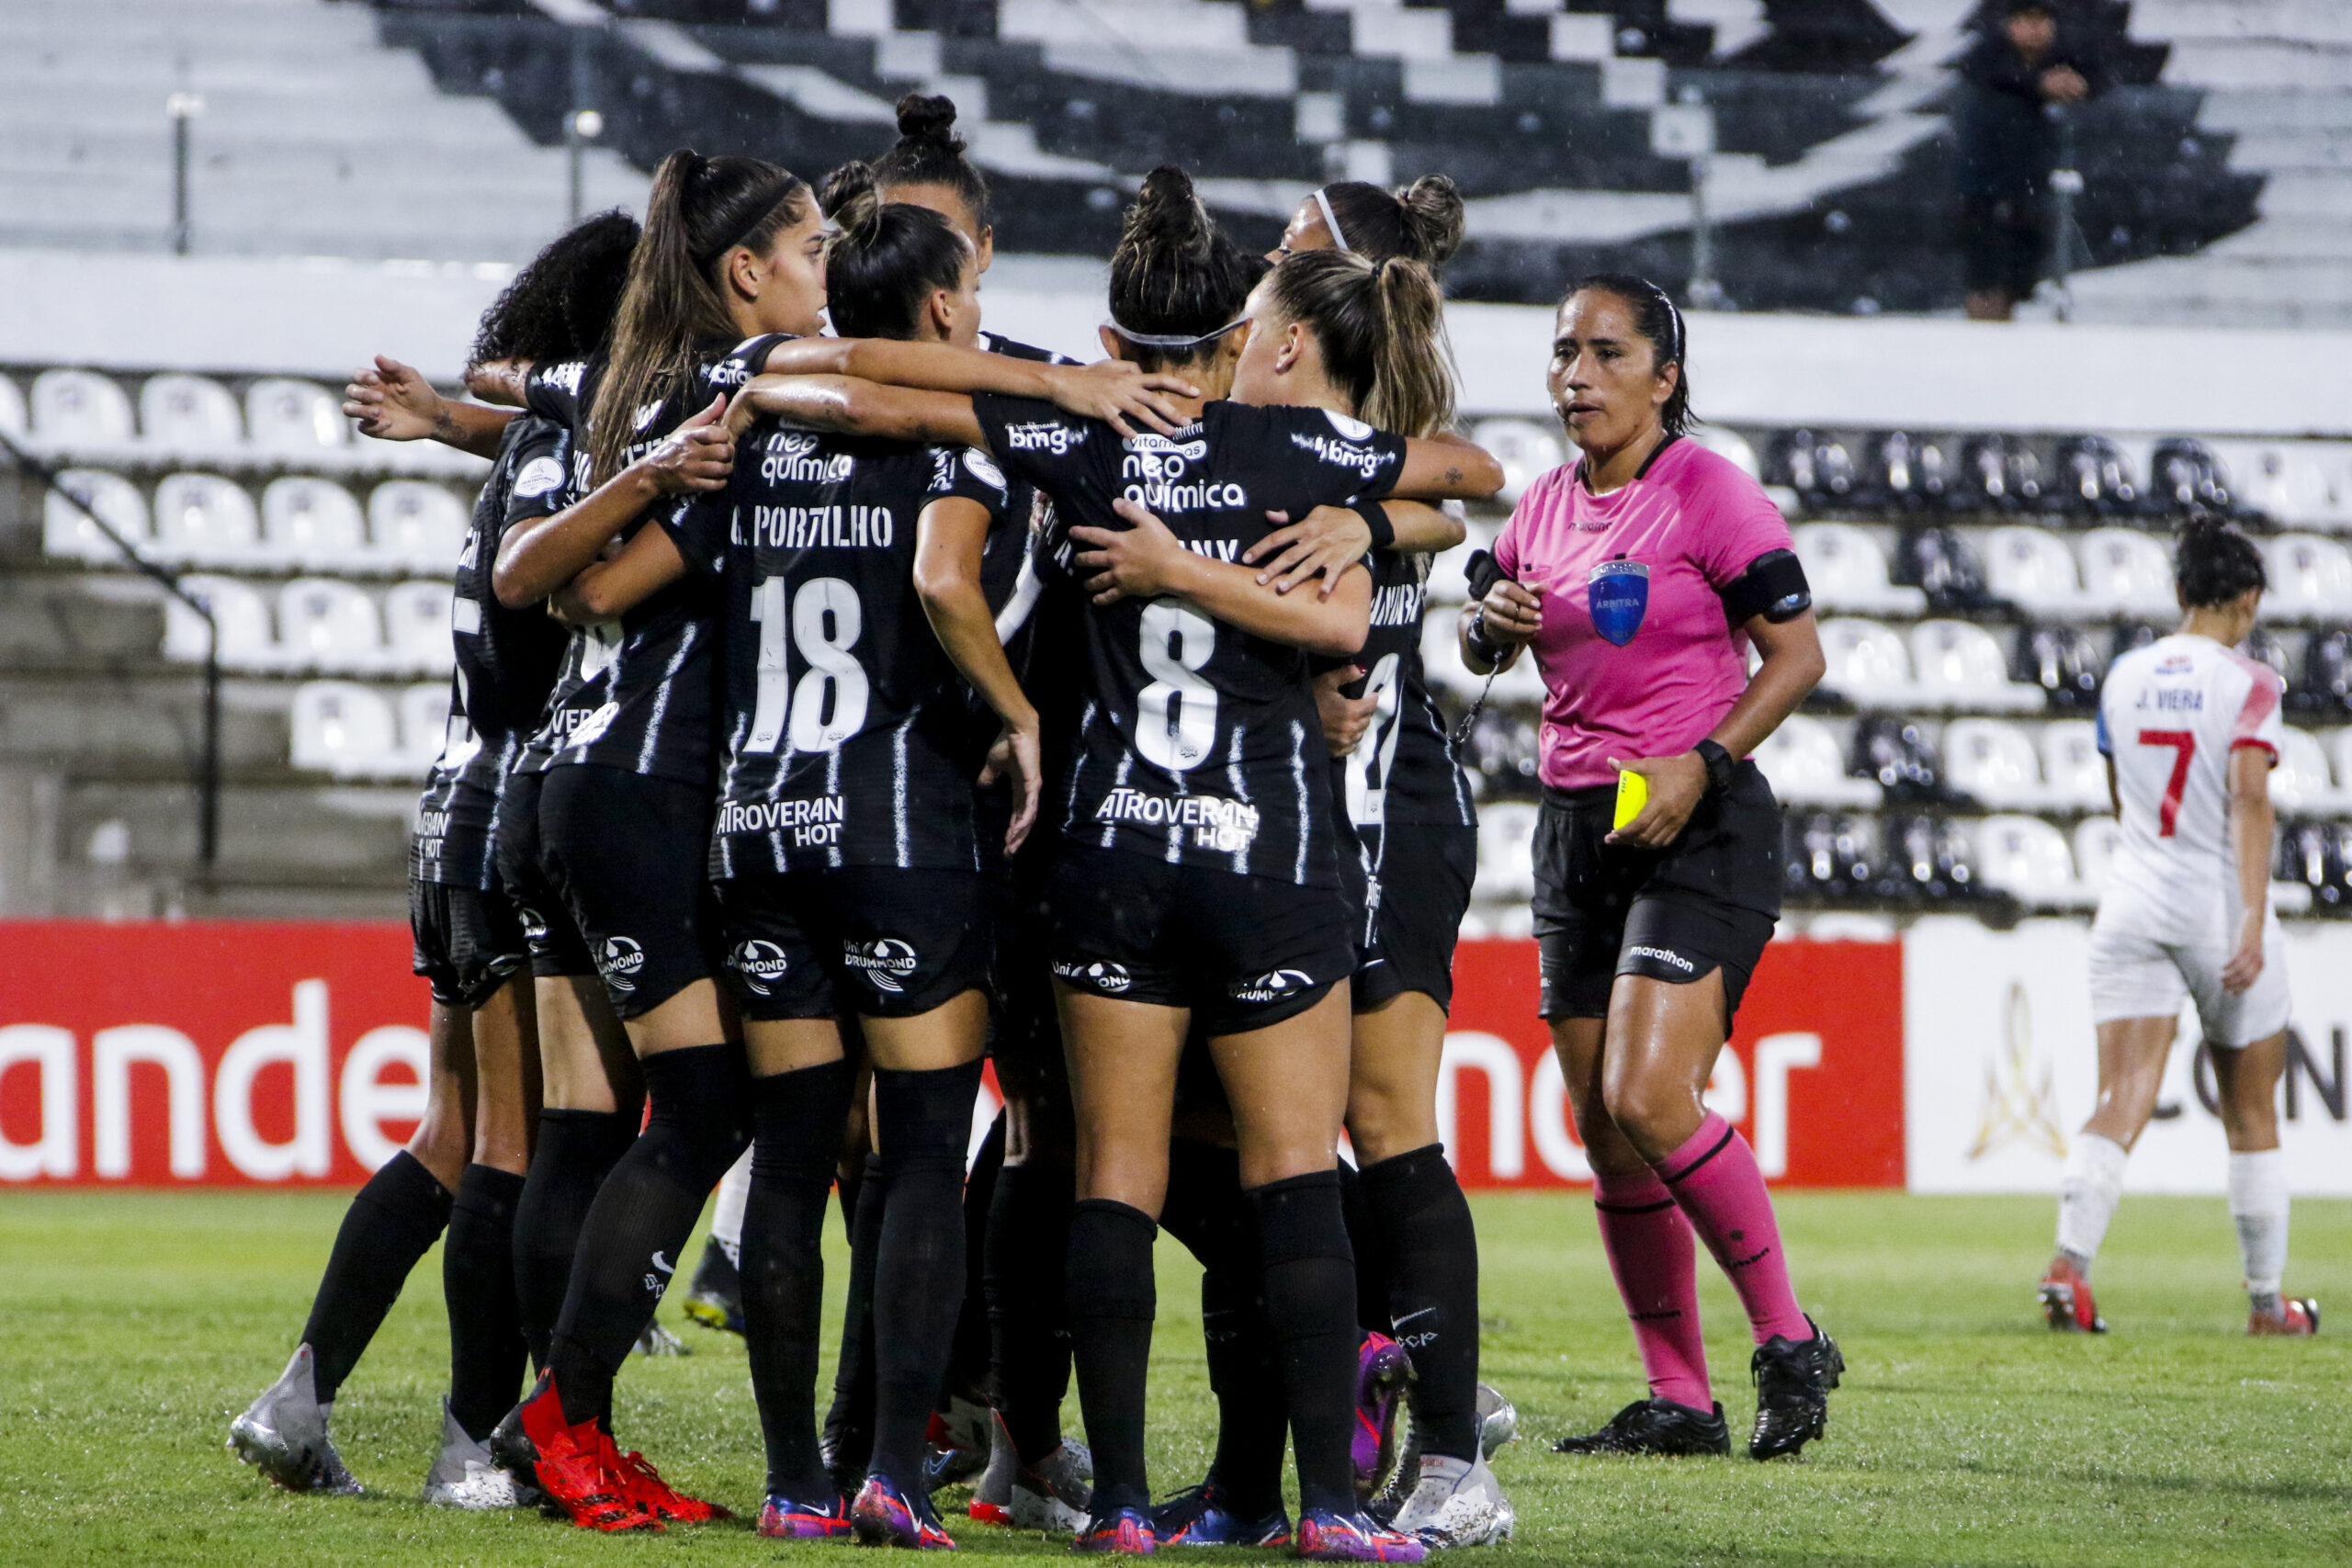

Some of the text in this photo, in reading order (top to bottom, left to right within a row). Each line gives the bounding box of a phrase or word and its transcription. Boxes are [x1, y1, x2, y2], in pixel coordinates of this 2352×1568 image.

[766, 430, 820, 454] neo
[1008, 425, 1068, 455] bmg
[1123, 454, 1185, 479] neo
[1327, 439, 1378, 479] bmg
[1123, 479, 1246, 513] química
[753, 505, 893, 548] PORTILHO
[742, 576, 869, 753] 18
[1135, 597, 1217, 771] 8
[2137, 728, 2197, 839] 7
[717, 795, 844, 836] ATROVERAN
[1095, 787, 1260, 829] ATROVERAN
[794, 822, 842, 848] HOT
[1196, 827, 1253, 852] HOT
[844, 953, 917, 970] DRUMMOND
[1630, 945, 1694, 974] marathon
